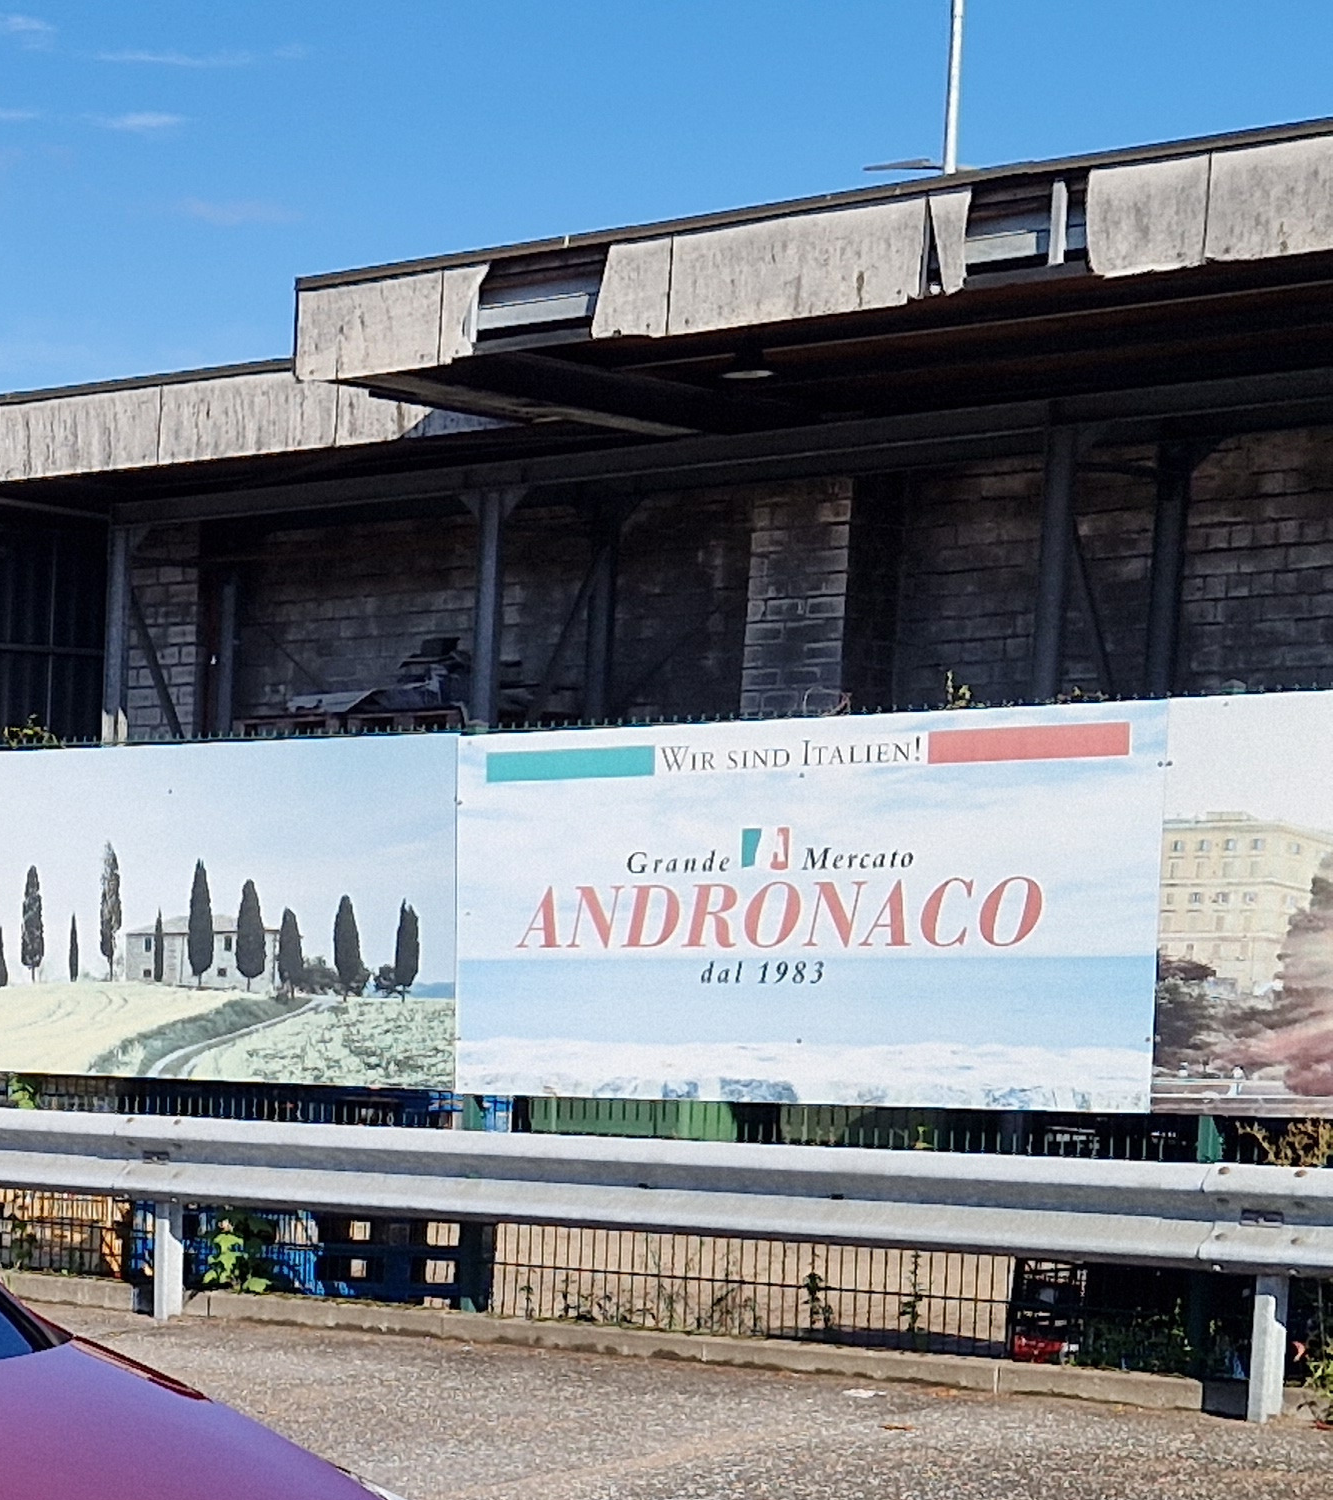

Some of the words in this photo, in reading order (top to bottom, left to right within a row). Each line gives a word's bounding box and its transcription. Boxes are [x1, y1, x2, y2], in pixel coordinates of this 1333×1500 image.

[626, 849, 732, 874] Grande
[801, 847, 915, 871] Mercato
[516, 876, 1043, 949] ANDRONACO
[700, 959, 742, 985] dal
[758, 960, 826, 985] 1983
